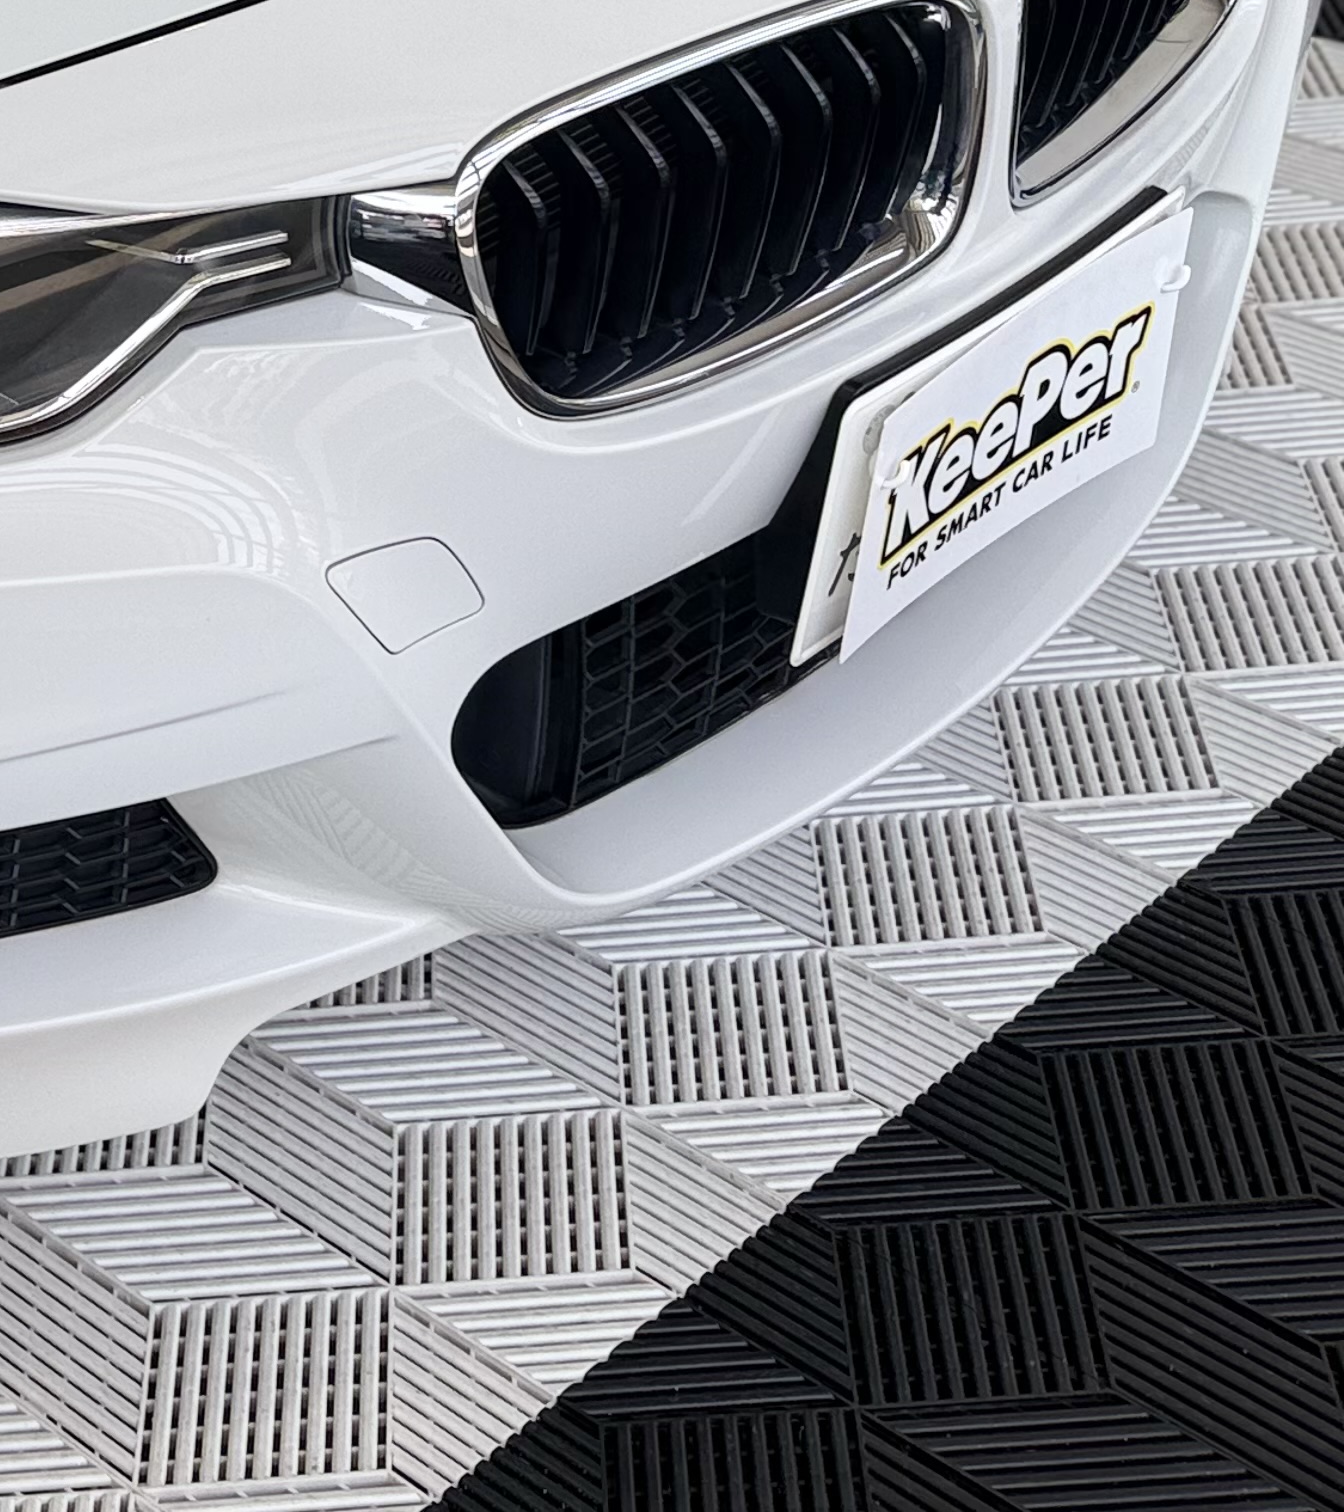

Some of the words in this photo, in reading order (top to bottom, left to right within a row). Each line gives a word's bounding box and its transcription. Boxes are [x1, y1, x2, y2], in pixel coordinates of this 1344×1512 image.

[879, 303, 1154, 568] KeePer
[886, 539, 928, 591] FOR
[934, 482, 1006, 552] SMART
[1012, 450, 1054, 493] CAR
[1061, 413, 1113, 464] LIFE
